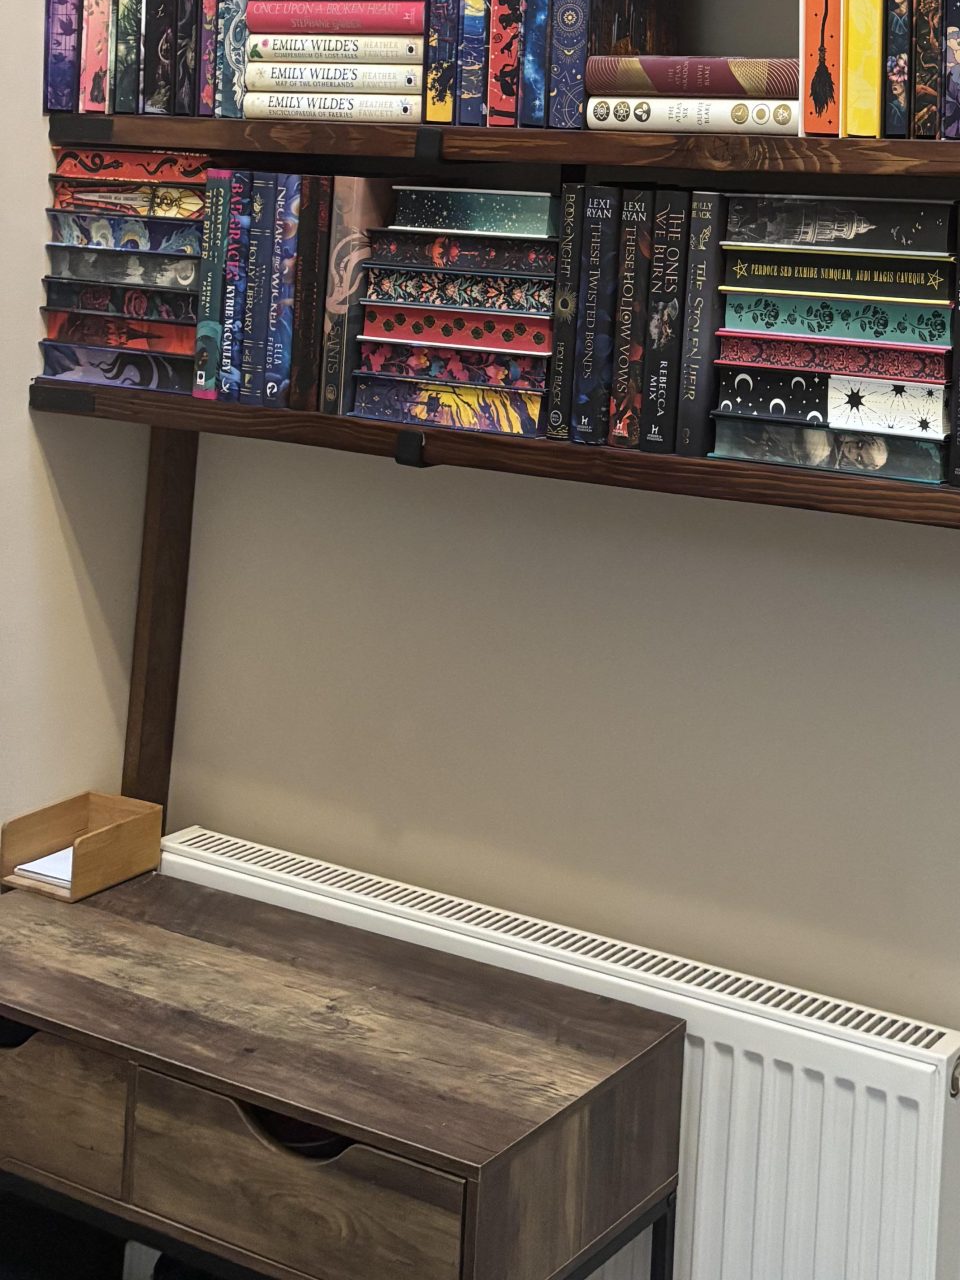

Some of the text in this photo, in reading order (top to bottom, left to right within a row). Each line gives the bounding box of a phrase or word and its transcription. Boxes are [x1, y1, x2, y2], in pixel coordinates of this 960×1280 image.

[272, 39, 359, 51] EMILY WILDE'S
[270, 67, 358, 80] EMILY WILDE'S
[268, 96, 354, 110] EMILY WILDE'S
[587, 199, 611, 209] LEXI
[587, 209, 612, 219] RYAN
[623, 201, 645, 212] LEXI
[622, 212, 647, 221] RYAN
[665, 210, 685, 292] THE ONES
[585, 222, 602, 327] THESE TWISTED
[651, 245, 666, 293] BURN
[751, 264, 777, 276] PERDOCE
[780, 266, 792, 277] SED
[856, 270, 871, 281] AUDI
[874, 271, 893, 282] MAGIS
[897, 272, 925, 285] CAVEQUE
[244, 282, 256, 333] LIBRARY
[617, 226, 637, 392] THESE VOWS
[221, 285, 235, 372] KYRIE McCAULEY
[274, 343, 282, 364] ELLA
[649, 375, 658, 400] MIX
[656, 361, 668, 416] REBECCA
